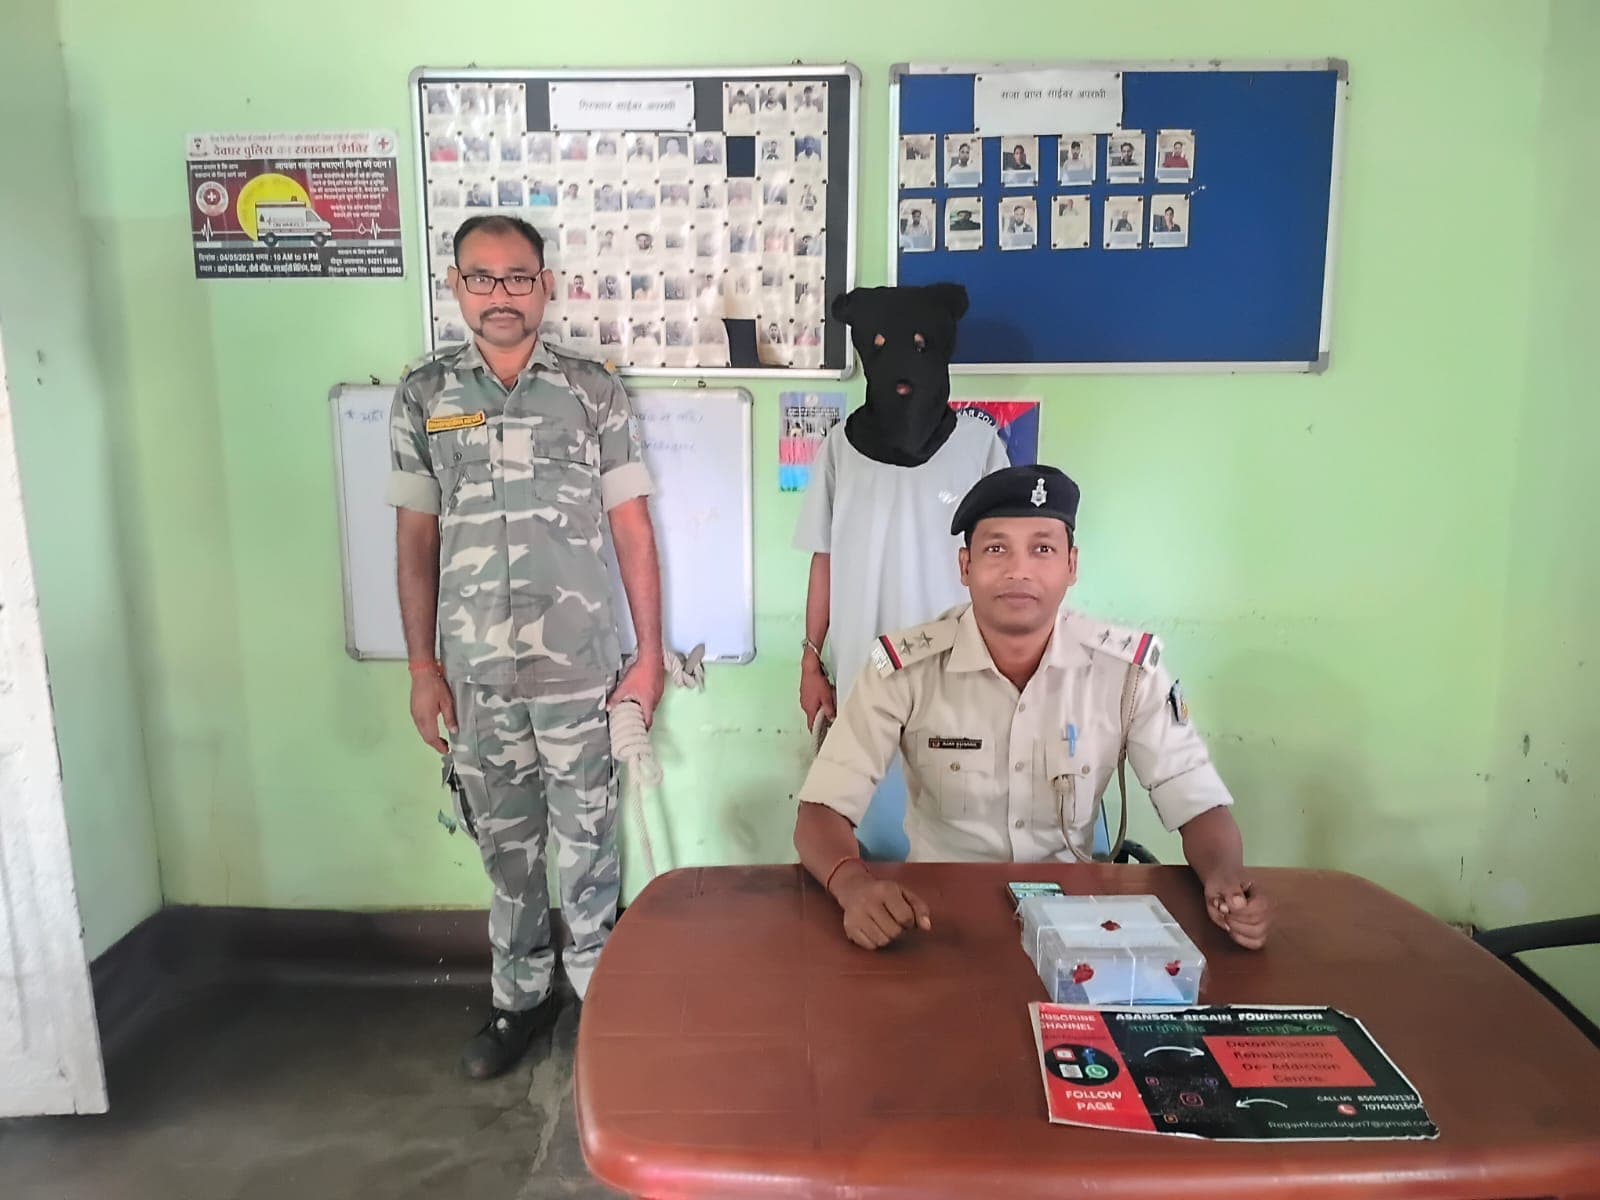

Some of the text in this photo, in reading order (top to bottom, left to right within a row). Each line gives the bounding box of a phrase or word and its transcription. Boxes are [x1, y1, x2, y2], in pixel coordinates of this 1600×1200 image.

[1116, 1013, 1323, 1022] ASANSOL REGAIN FOUNDATION
[1226, 1040, 1325, 1048] Detoxification
[1272, 1062, 1341, 1071] Addiction
[1066, 1090, 1122, 1100] FOLLOW
[1076, 1102, 1115, 1112] PAGE
